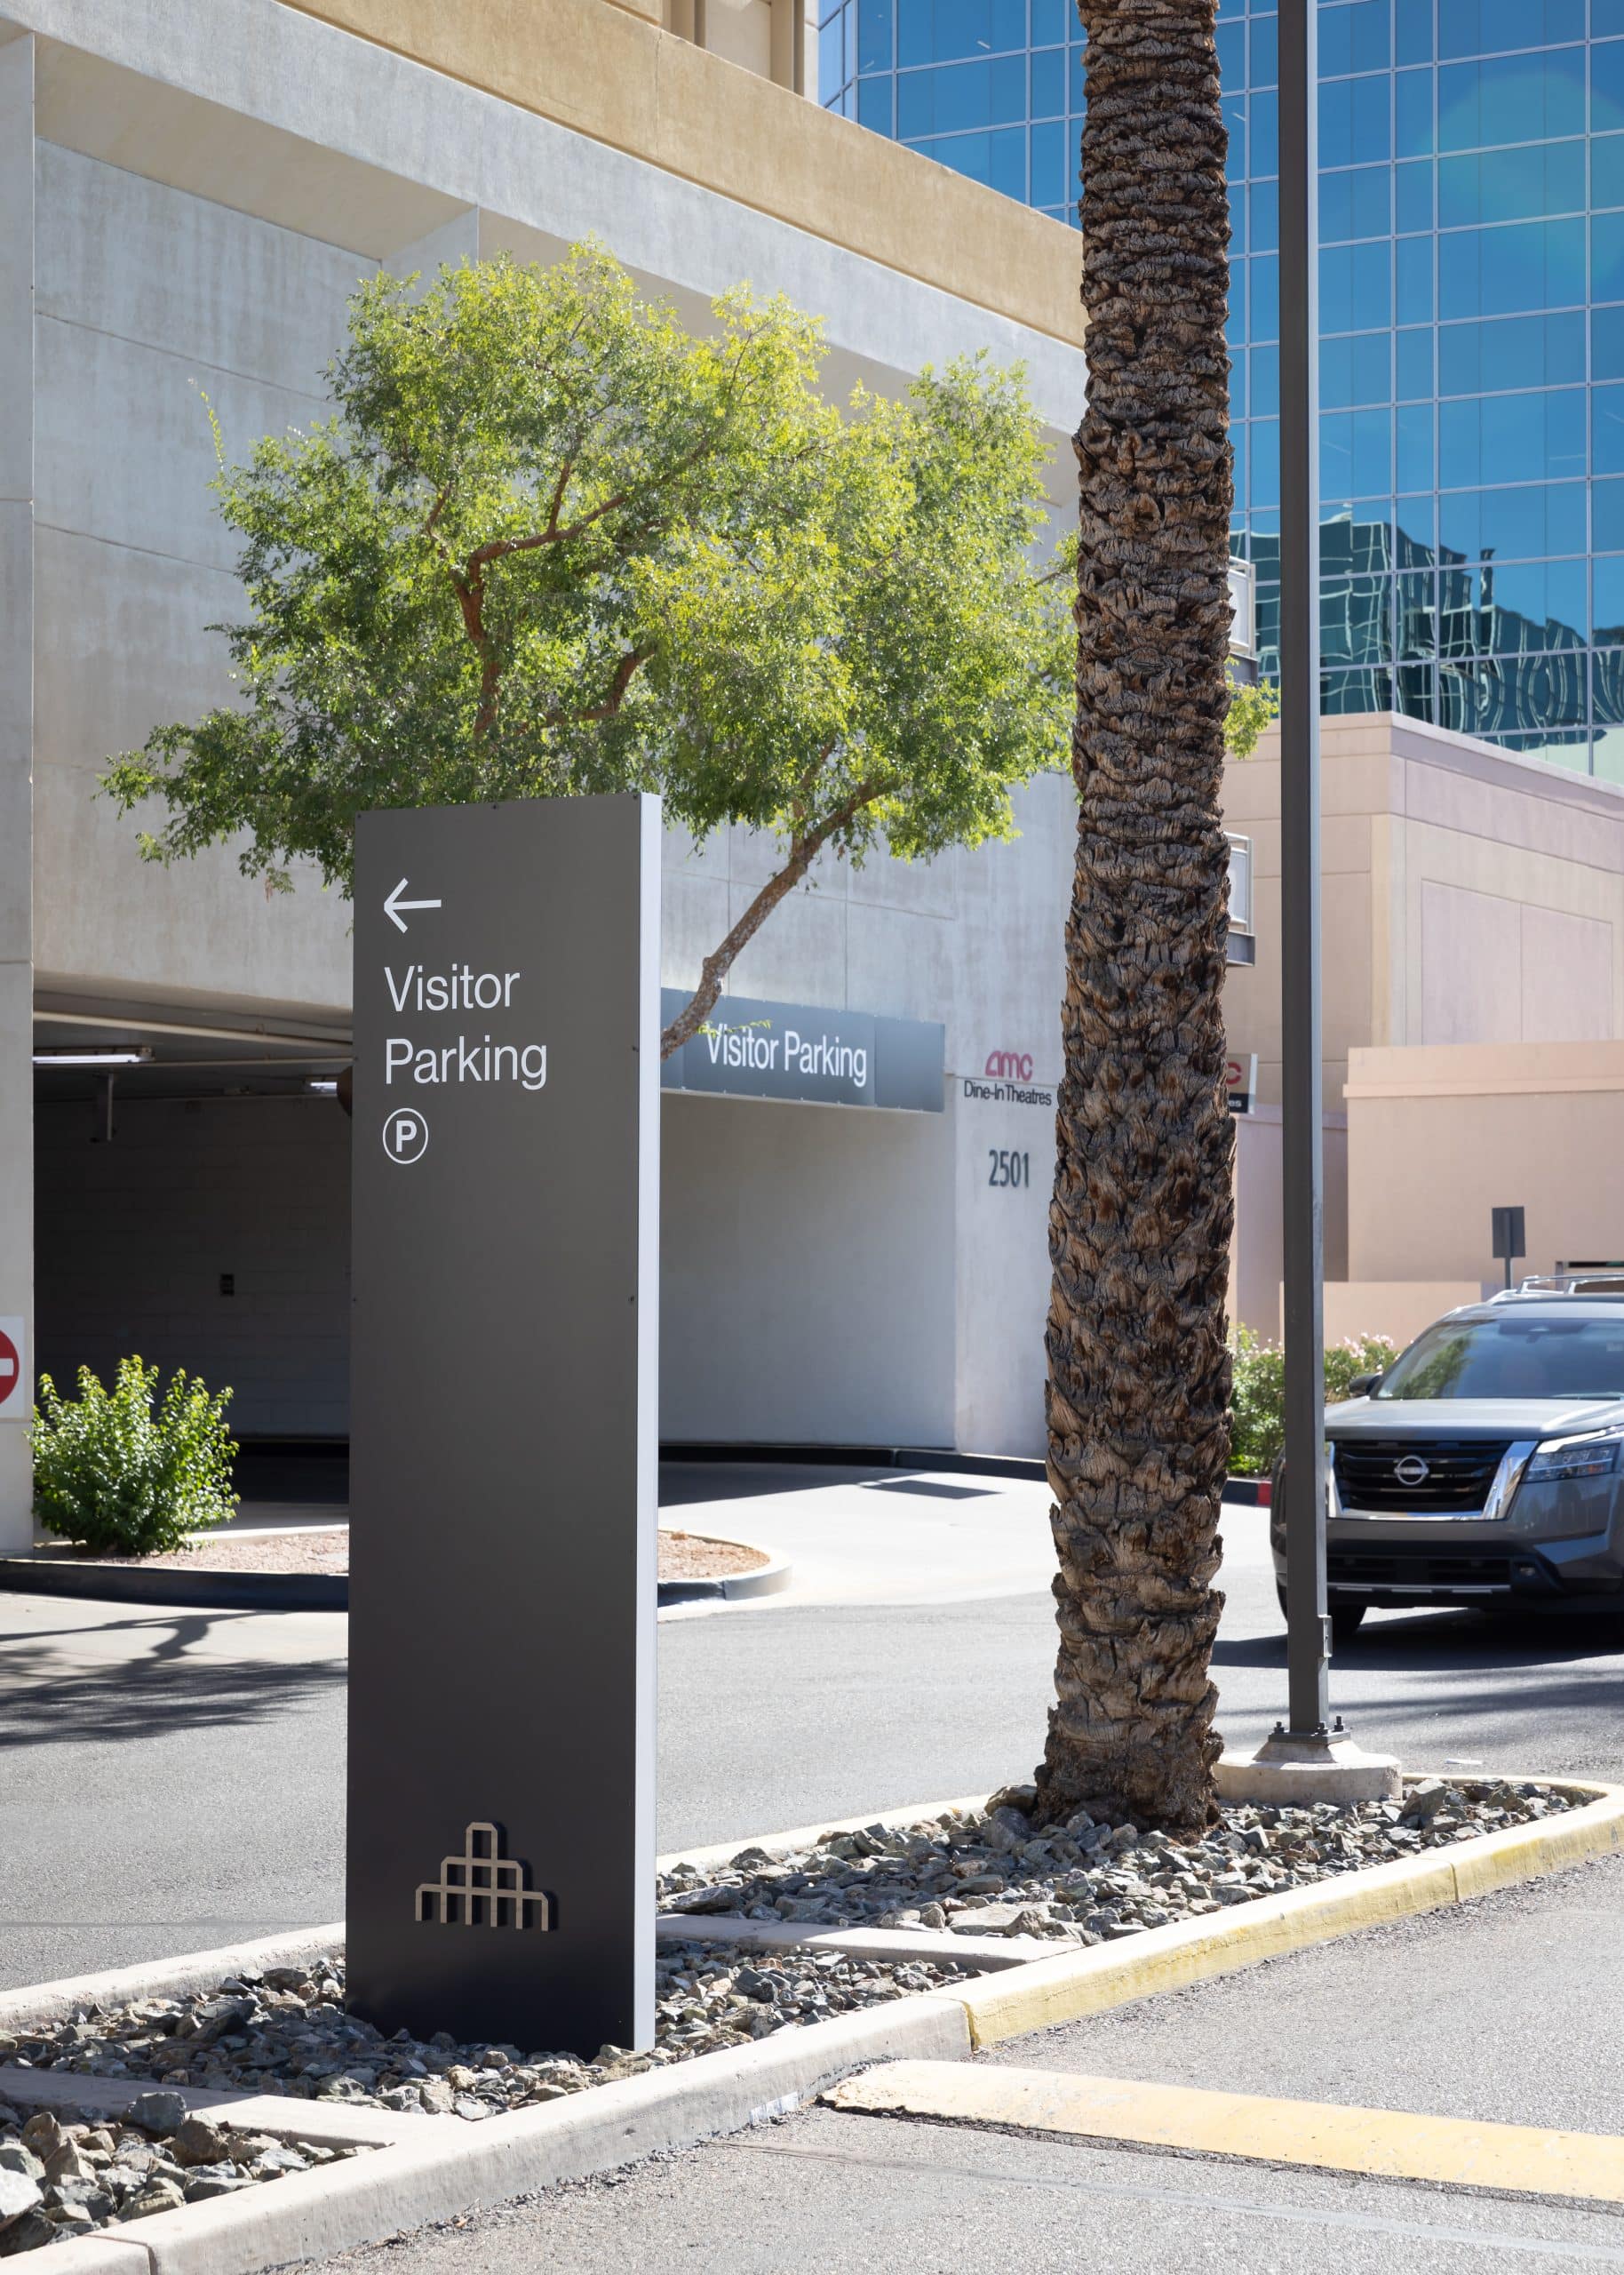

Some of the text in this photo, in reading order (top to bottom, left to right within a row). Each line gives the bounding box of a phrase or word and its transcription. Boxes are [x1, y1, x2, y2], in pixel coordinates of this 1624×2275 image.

[384, 963, 521, 1012] Visitor
[386, 1034, 547, 1090] Parking
[706, 1023, 867, 1089] Visitor Parking
[985, 1050, 1033, 1082] amc
[964, 1080, 1053, 1106] Dine-In Theatres
[395, 1120, 418, 1153] P
[988, 1149, 1030, 1188] 2501
